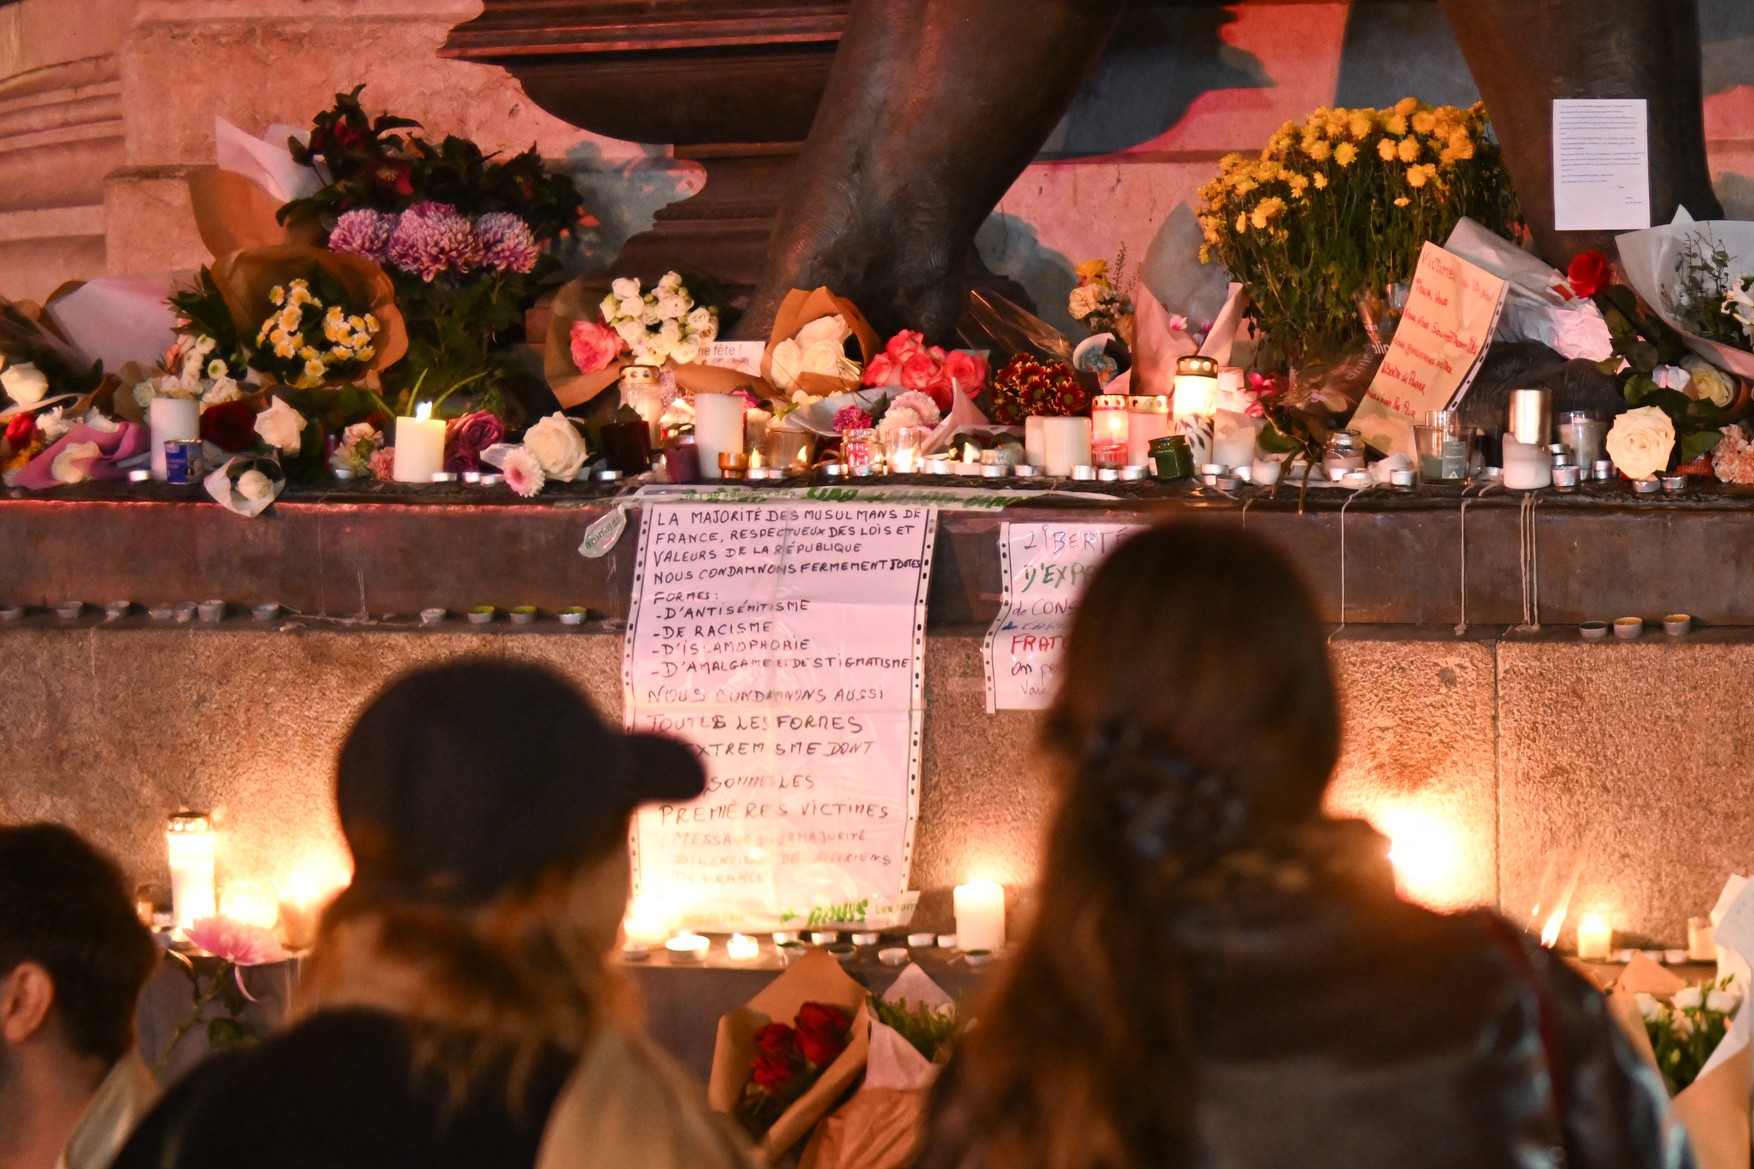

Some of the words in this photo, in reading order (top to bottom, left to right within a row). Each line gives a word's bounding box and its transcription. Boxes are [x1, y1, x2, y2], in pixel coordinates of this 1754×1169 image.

[713, 344, 736, 356] fête
[658, 512, 679, 526] LA
[765, 510, 799, 522] DES
[804, 509, 898, 522] MUSULMANS
[903, 509, 921, 518] DE
[656, 532, 723, 544] FRANCE,
[730, 526, 825, 540] RESPECTUEUX
[828, 526, 856, 538] DES
[896, 525, 915, 535] ET
[653, 550, 717, 567] VALEURS
[725, 546, 747, 558] DE
[753, 545, 769, 555] LA
[774, 541, 862, 555] RÉPUBLIQUE
[654, 571, 693, 585] NOUS
[699, 564, 797, 579] CONDAMNONS
[800, 560, 888, 573] FERMEMENT
[1012, 600, 1027, 616] de
[1032, 598, 1080, 615] CONS
[695, 621, 773, 638] RACISME
[1011, 633, 1069, 654] FRATE
[648, 685, 706, 704] NOUS
[647, 714, 727, 734] TOUTES
[736, 715, 769, 730] LES
[822, 741, 875, 756] DONT
[778, 774, 814, 789] LES
[659, 799, 788, 826] PREMIÈRES
